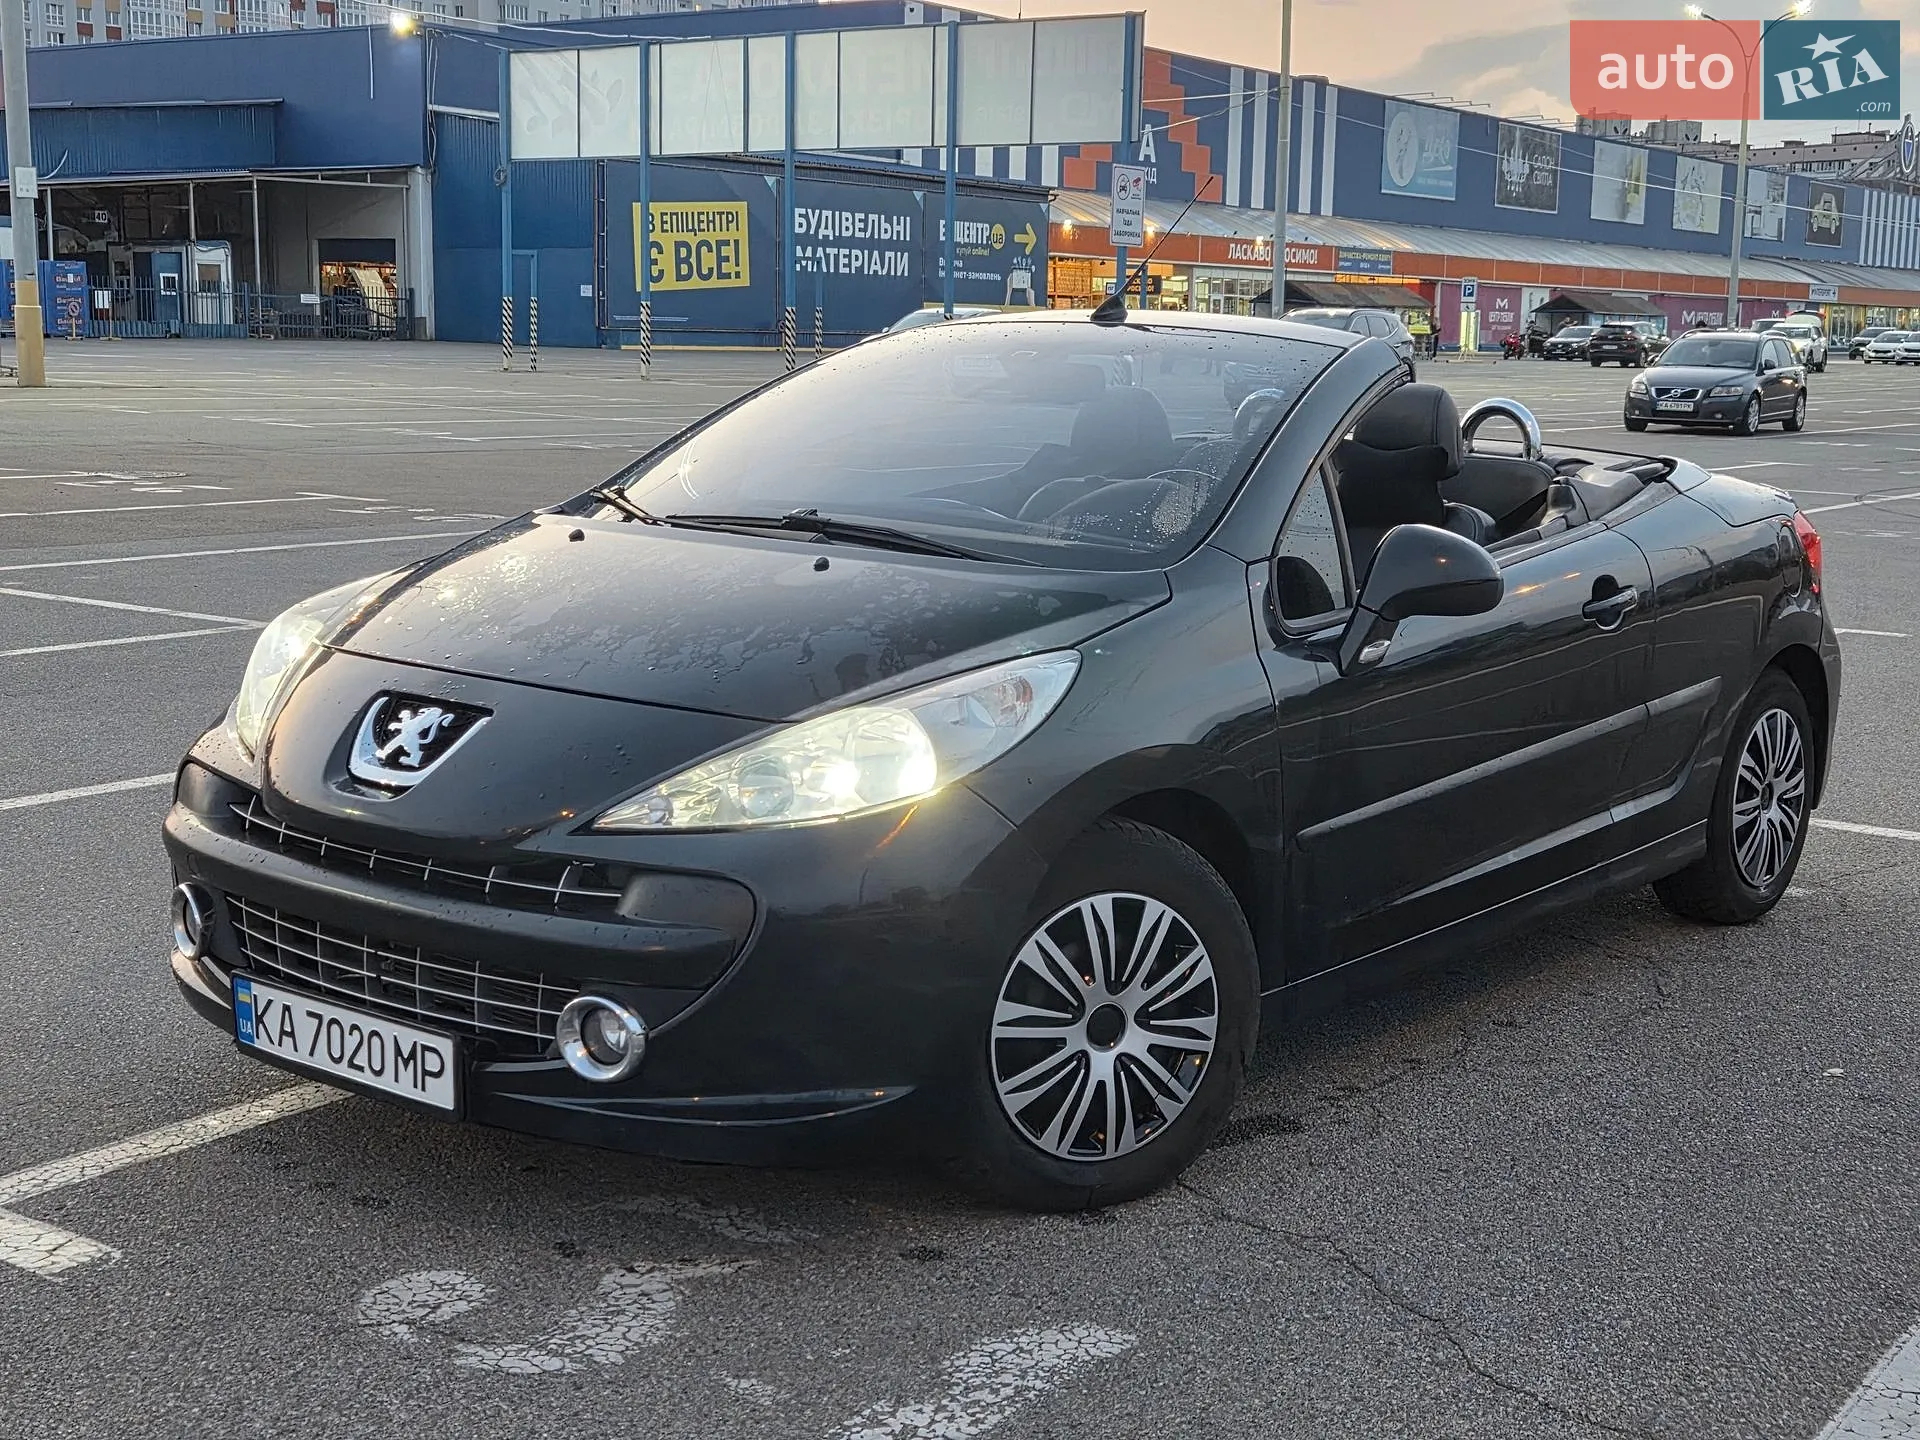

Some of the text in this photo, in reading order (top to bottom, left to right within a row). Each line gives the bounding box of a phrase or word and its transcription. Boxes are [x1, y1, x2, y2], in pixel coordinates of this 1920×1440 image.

[660, 211, 739, 236] ЕПІЦЕНТРІ
[794, 207, 911, 241] БУДІВЕЛЬНІ
[674, 239, 742, 282] ВСЕ!
[796, 245, 909, 277] МАТЕРІАЛИ
[1228, 243, 1318, 265] ЛАСКАВО ОСИМО!
[240, 1018, 253, 1037] UA
[253, 992, 445, 1092] KA 7020 MP
